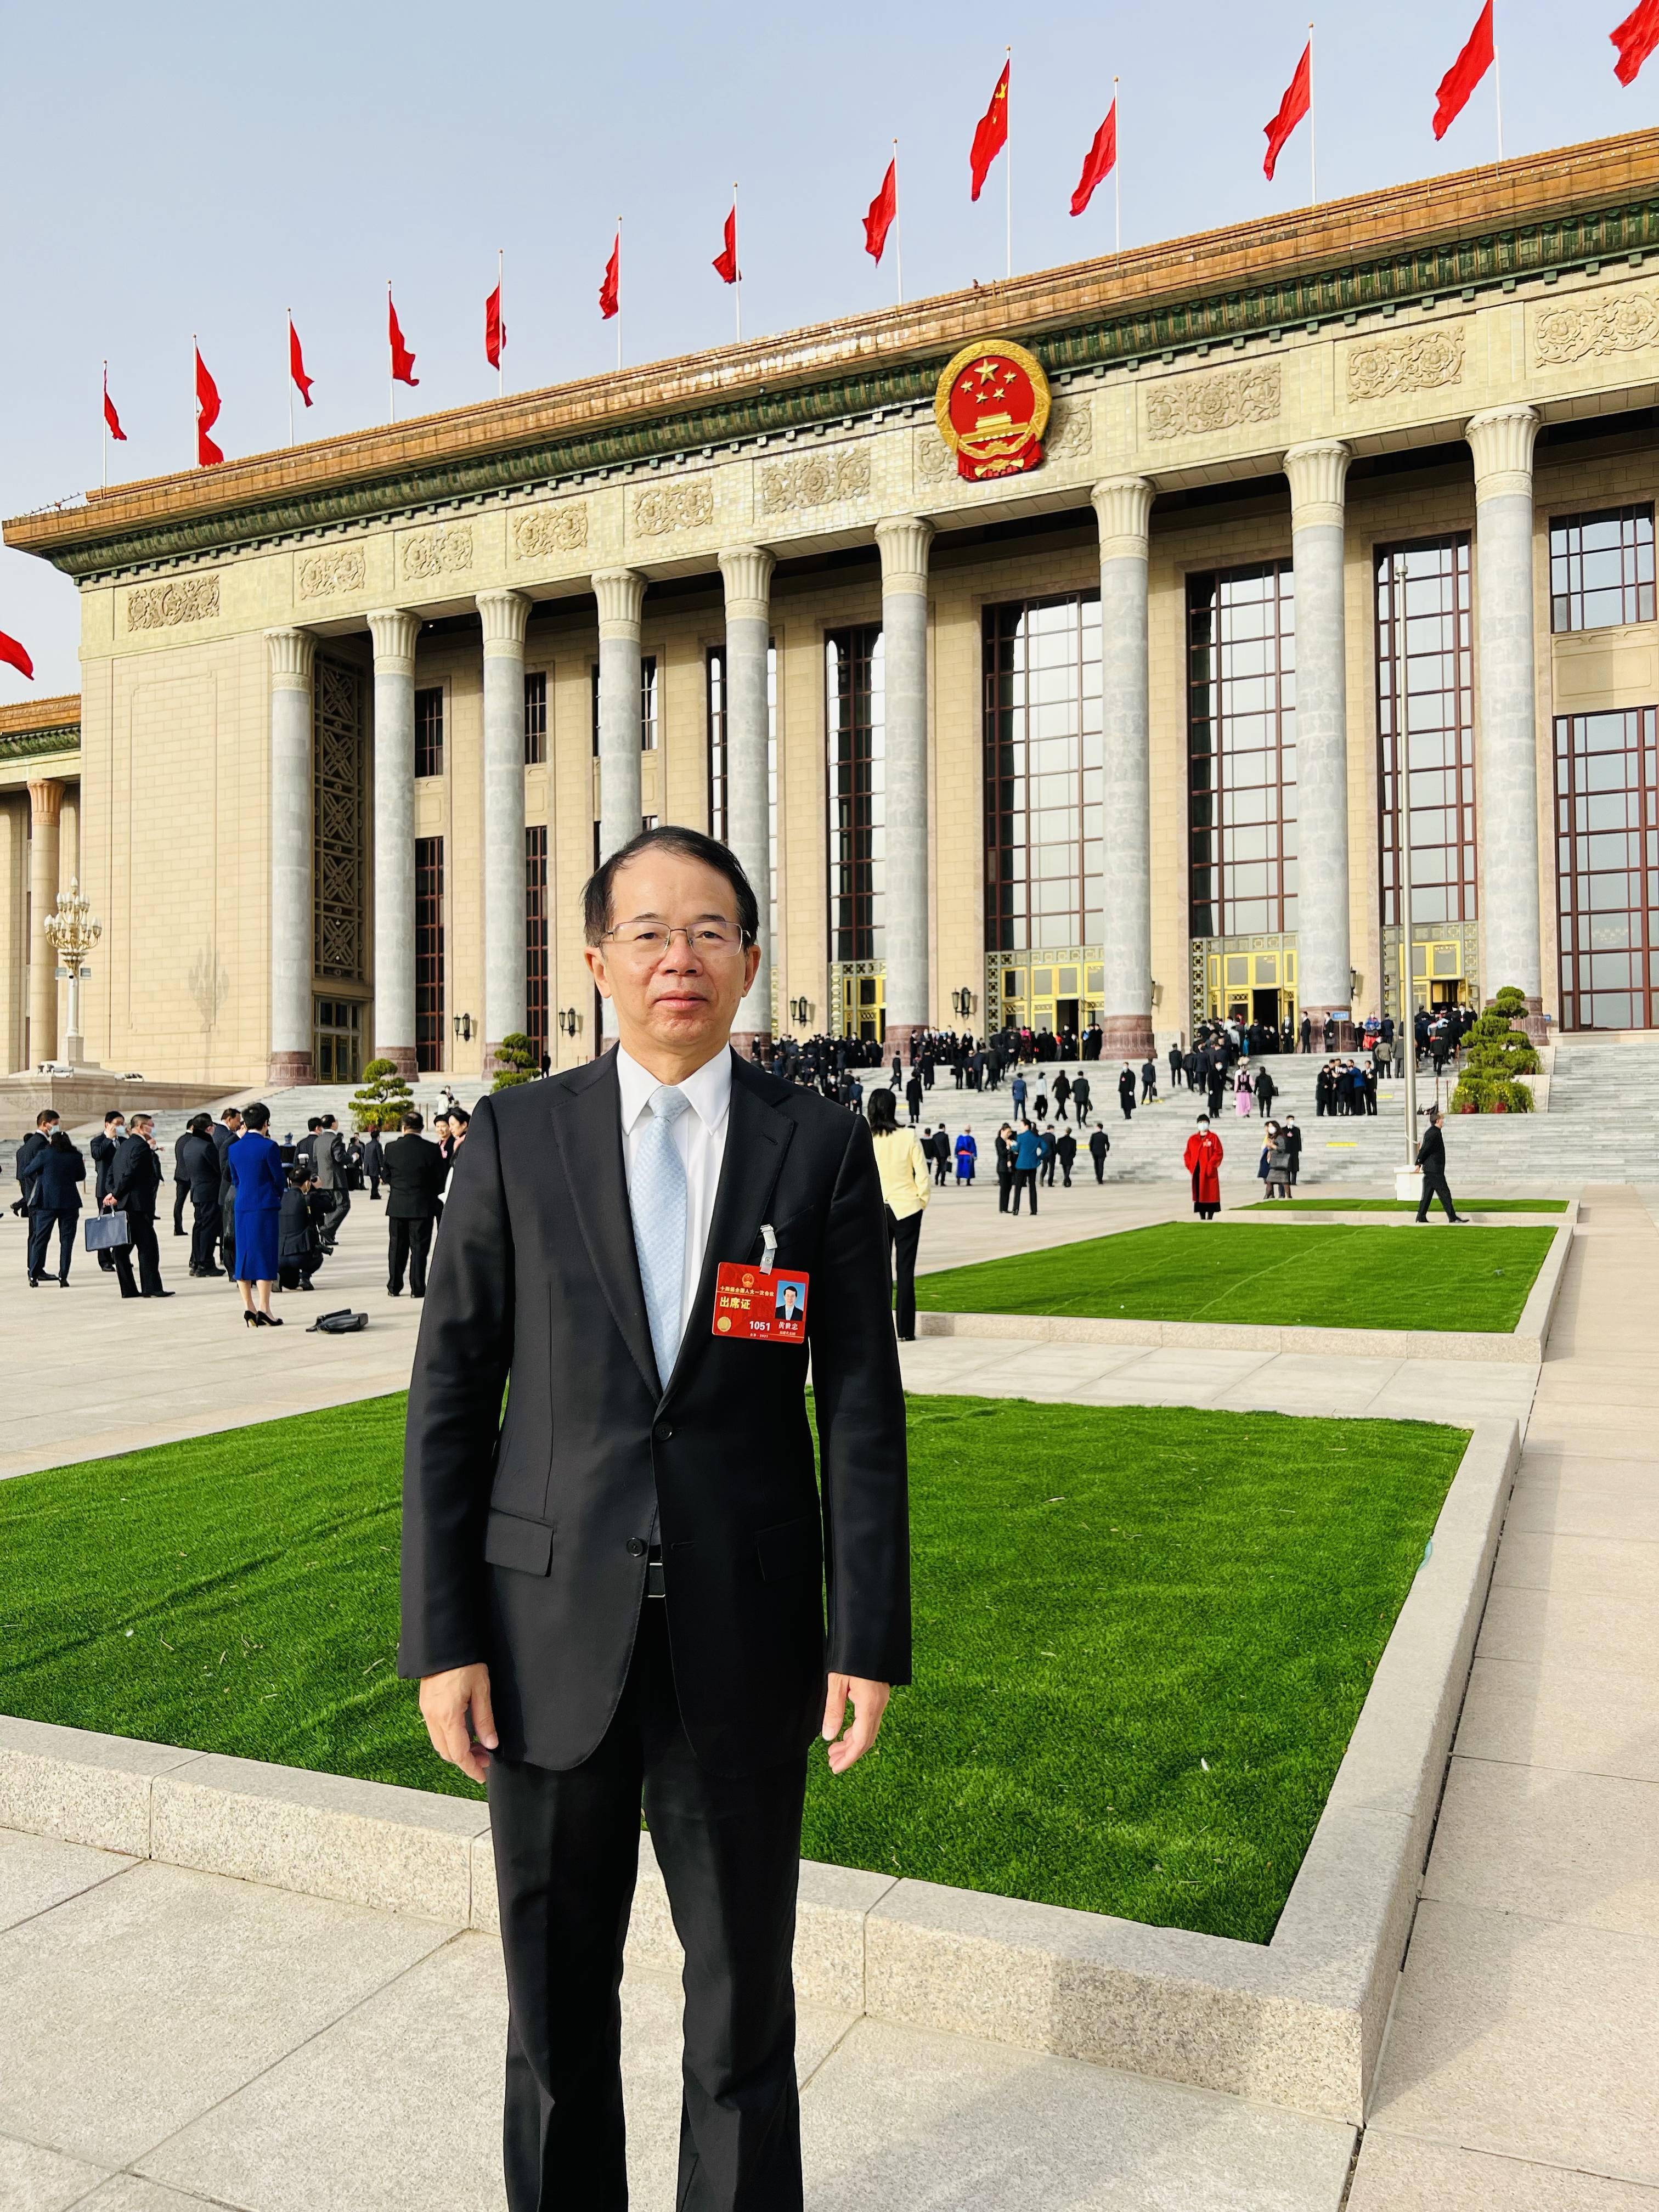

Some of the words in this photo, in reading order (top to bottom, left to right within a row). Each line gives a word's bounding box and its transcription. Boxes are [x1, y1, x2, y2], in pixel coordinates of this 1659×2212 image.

[719, 1296, 751, 1310] 出席证
[749, 1321, 770, 1331] 1051
